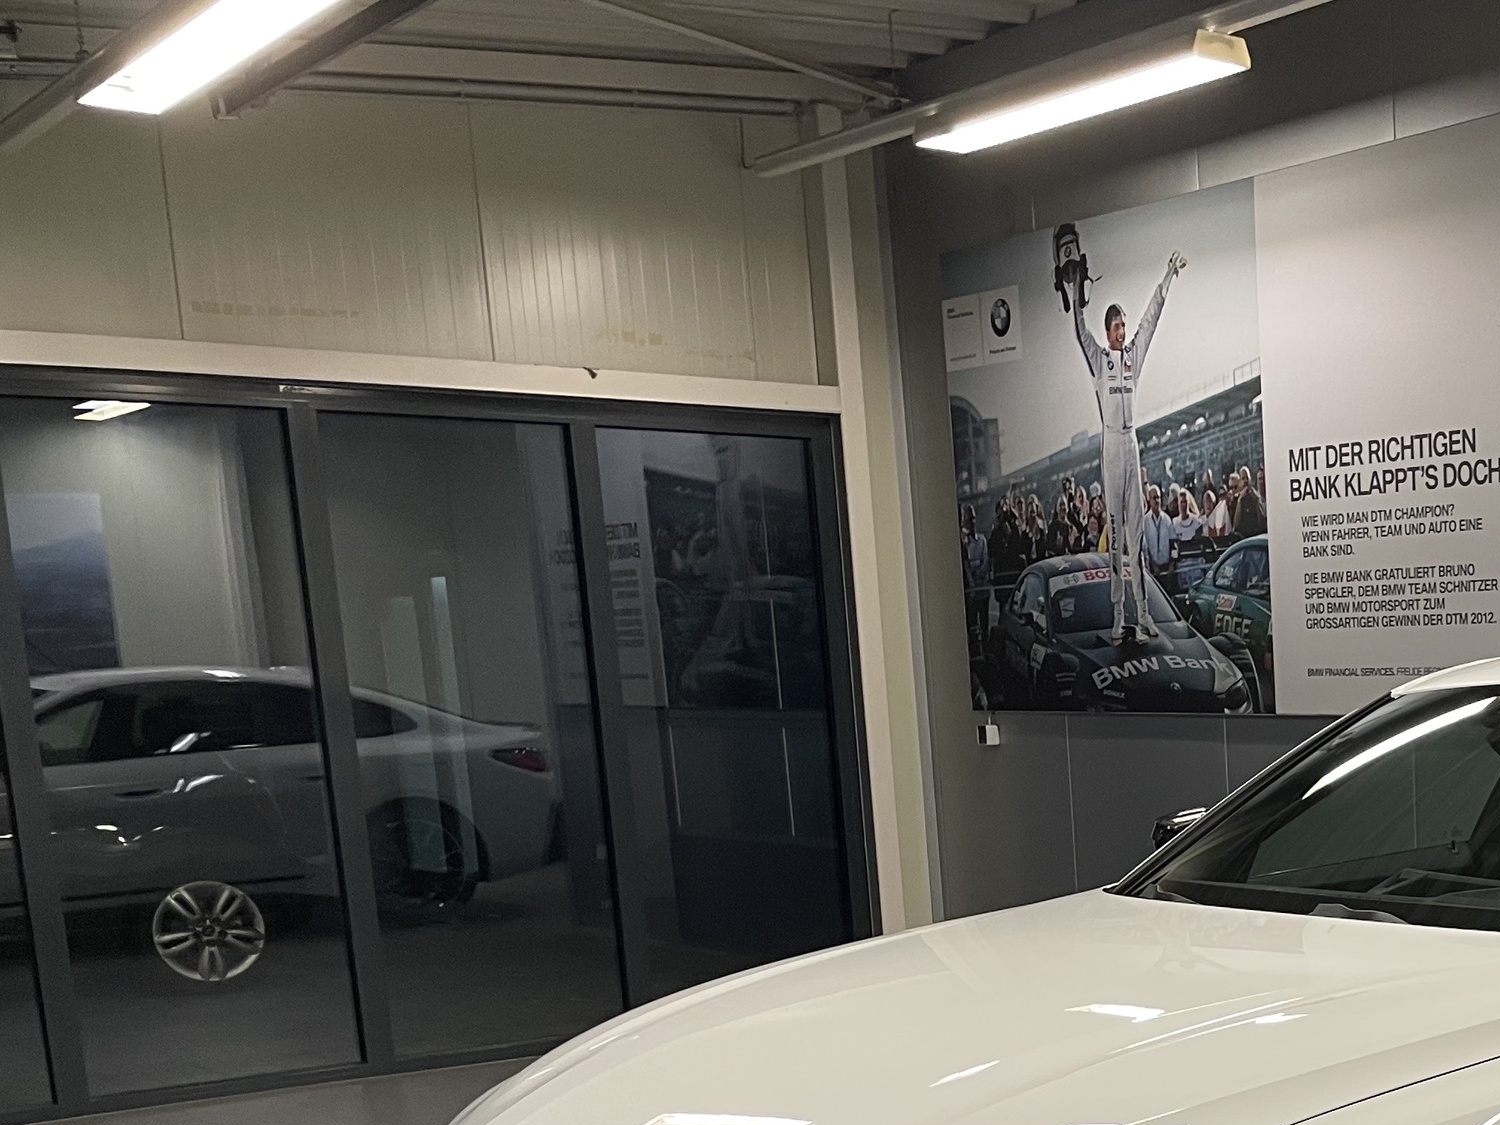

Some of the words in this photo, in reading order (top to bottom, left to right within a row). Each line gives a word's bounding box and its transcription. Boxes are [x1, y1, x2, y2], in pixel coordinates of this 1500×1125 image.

[1289, 446, 1322, 472] MIT
[1325, 442, 1364, 469] DER
[1368, 428, 1477, 464] RICHTIGEN
[1290, 474, 1341, 502] BANK
[1301, 515, 1319, 527] WIE
[1320, 512, 1344, 526] WIRD
[1346, 511, 1369, 524] MAN
[1370, 509, 1392, 522] DTM
[1395, 504, 1455, 520] CHAMPION?
[1302, 531, 1330, 543] WENN
[1331, 527, 1373, 540] FAHRER,
[1374, 526, 1402, 537] TEAM
[1404, 522, 1426, 535] UND
[1428, 520, 1457, 534] AUTO
[1459, 517, 1483, 532] EINE
[1303, 546, 1329, 558] BANK
[1330, 543, 1355, 556] SIND.
[1304, 572, 1320, 584] DIE
[1321, 571, 1344, 583] BMW
[1346, 570, 1373, 582] BANK
[1374, 565, 1437, 580] GRATULIERT
[1438, 563, 1475, 577] BRUNO
[1304, 587, 1356, 600] SPENGLER,
[1358, 585, 1379, 597] DEM
[1381, 584, 1406, 596] BMW
[1408, 582, 1437, 595] TEAM
[1439, 578, 1499, 593] SCHNITZER
[1305, 602, 1325, 614] UND
[1327, 601, 1350, 613] BMW
[1352, 599, 1421, 613] MOTORSPORT
[1423, 598, 1446, 610] ZUM
[1305, 616, 1379, 629] GROSSARTIGEN
[1381, 615, 1421, 628] GEWINN
[1422, 614, 1444, 626] DER
[1445, 613, 1469, 625] DTM
[1470, 611, 1497, 625] 2012.
[1091, 656, 1160, 690] BMW
[1162, 655, 1234, 677] Bank
[1307, 667, 1324, 677] BMW
[1325, 667, 1360, 677] FINANCIAL
[1360, 667, 1396, 677] SERVICES.
